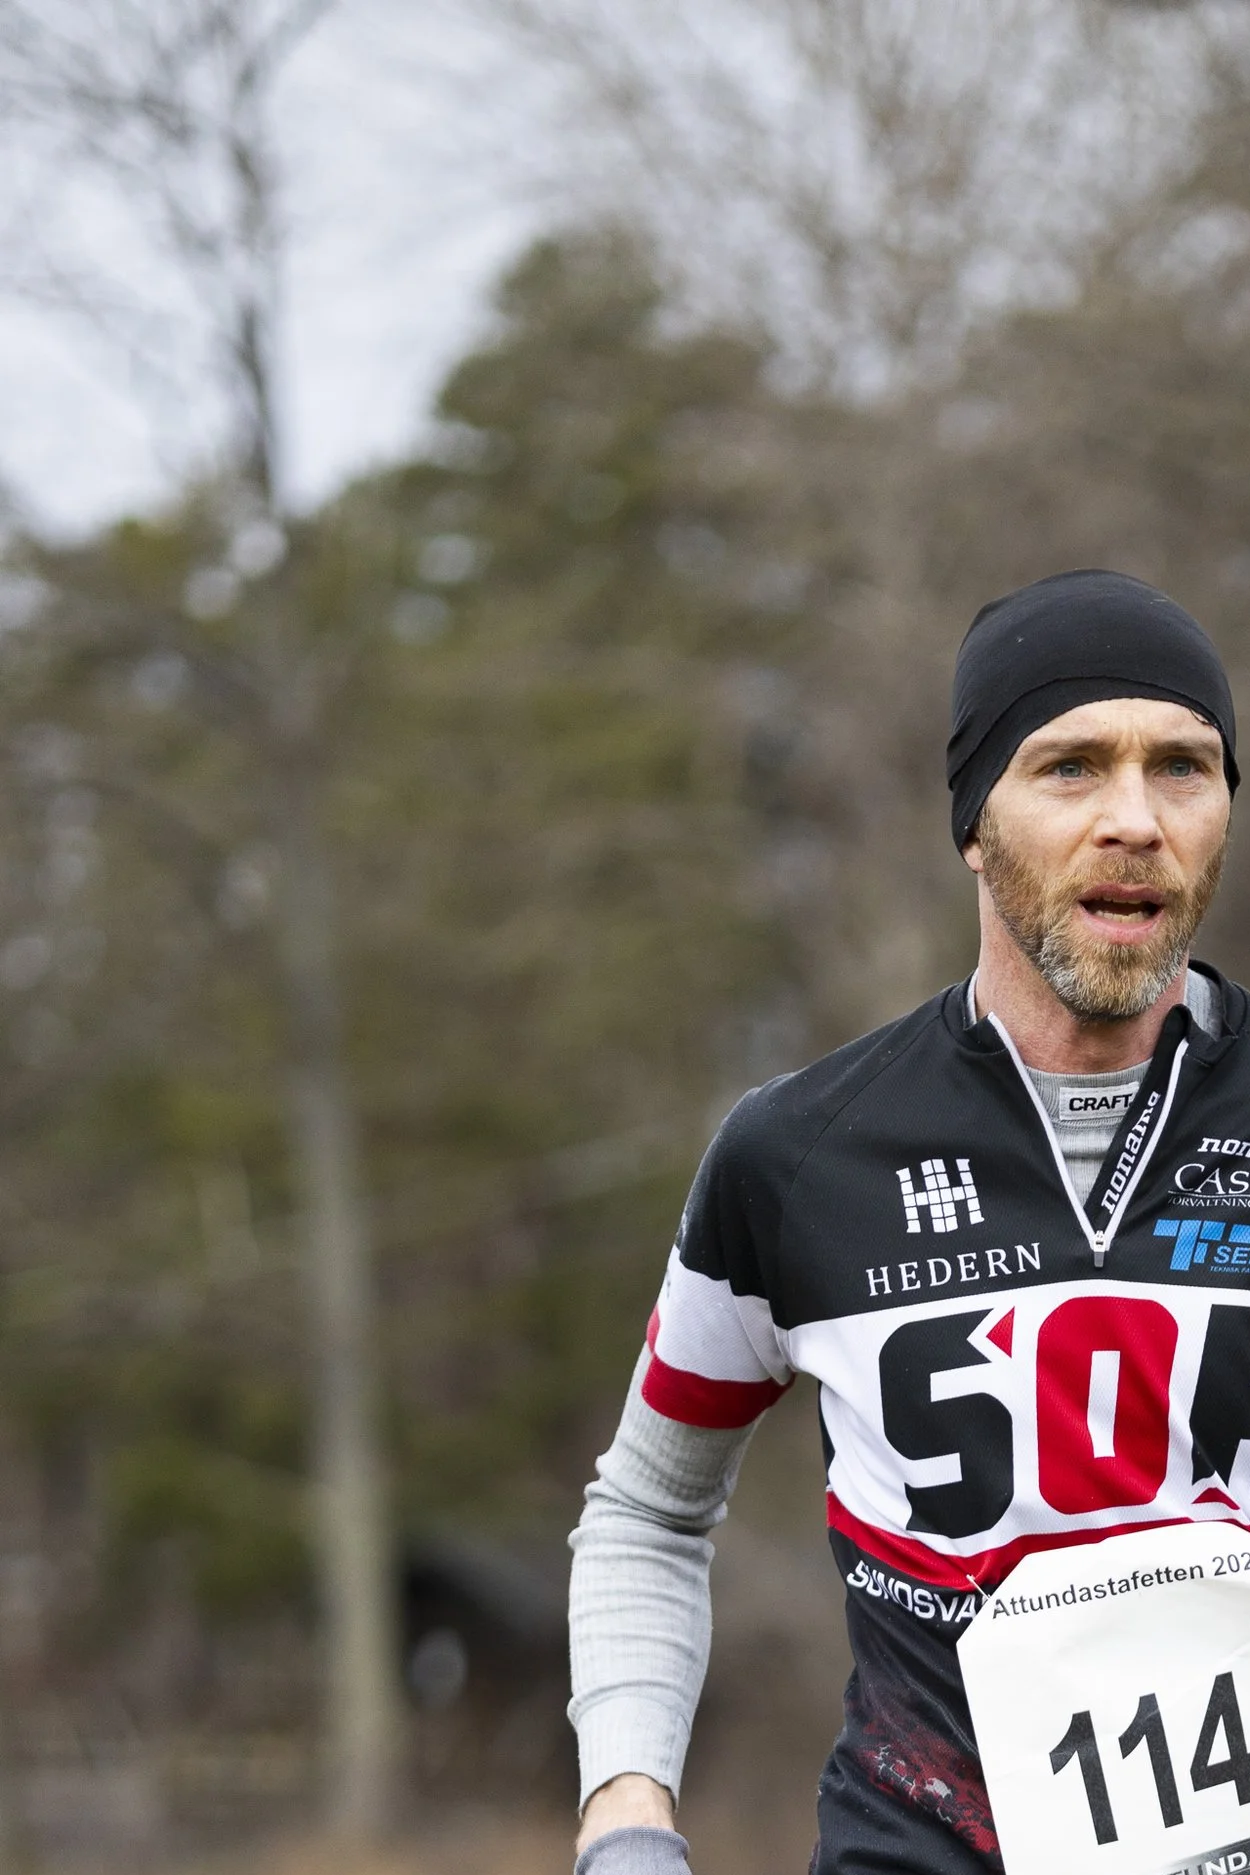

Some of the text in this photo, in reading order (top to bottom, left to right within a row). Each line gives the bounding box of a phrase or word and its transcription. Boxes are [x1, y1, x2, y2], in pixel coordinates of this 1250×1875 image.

[1068, 1093, 1133, 1112] CRAFT
[865, 1242, 1042, 1297] HEDERN
[991, 1563, 1205, 1620] Attundastafetten
